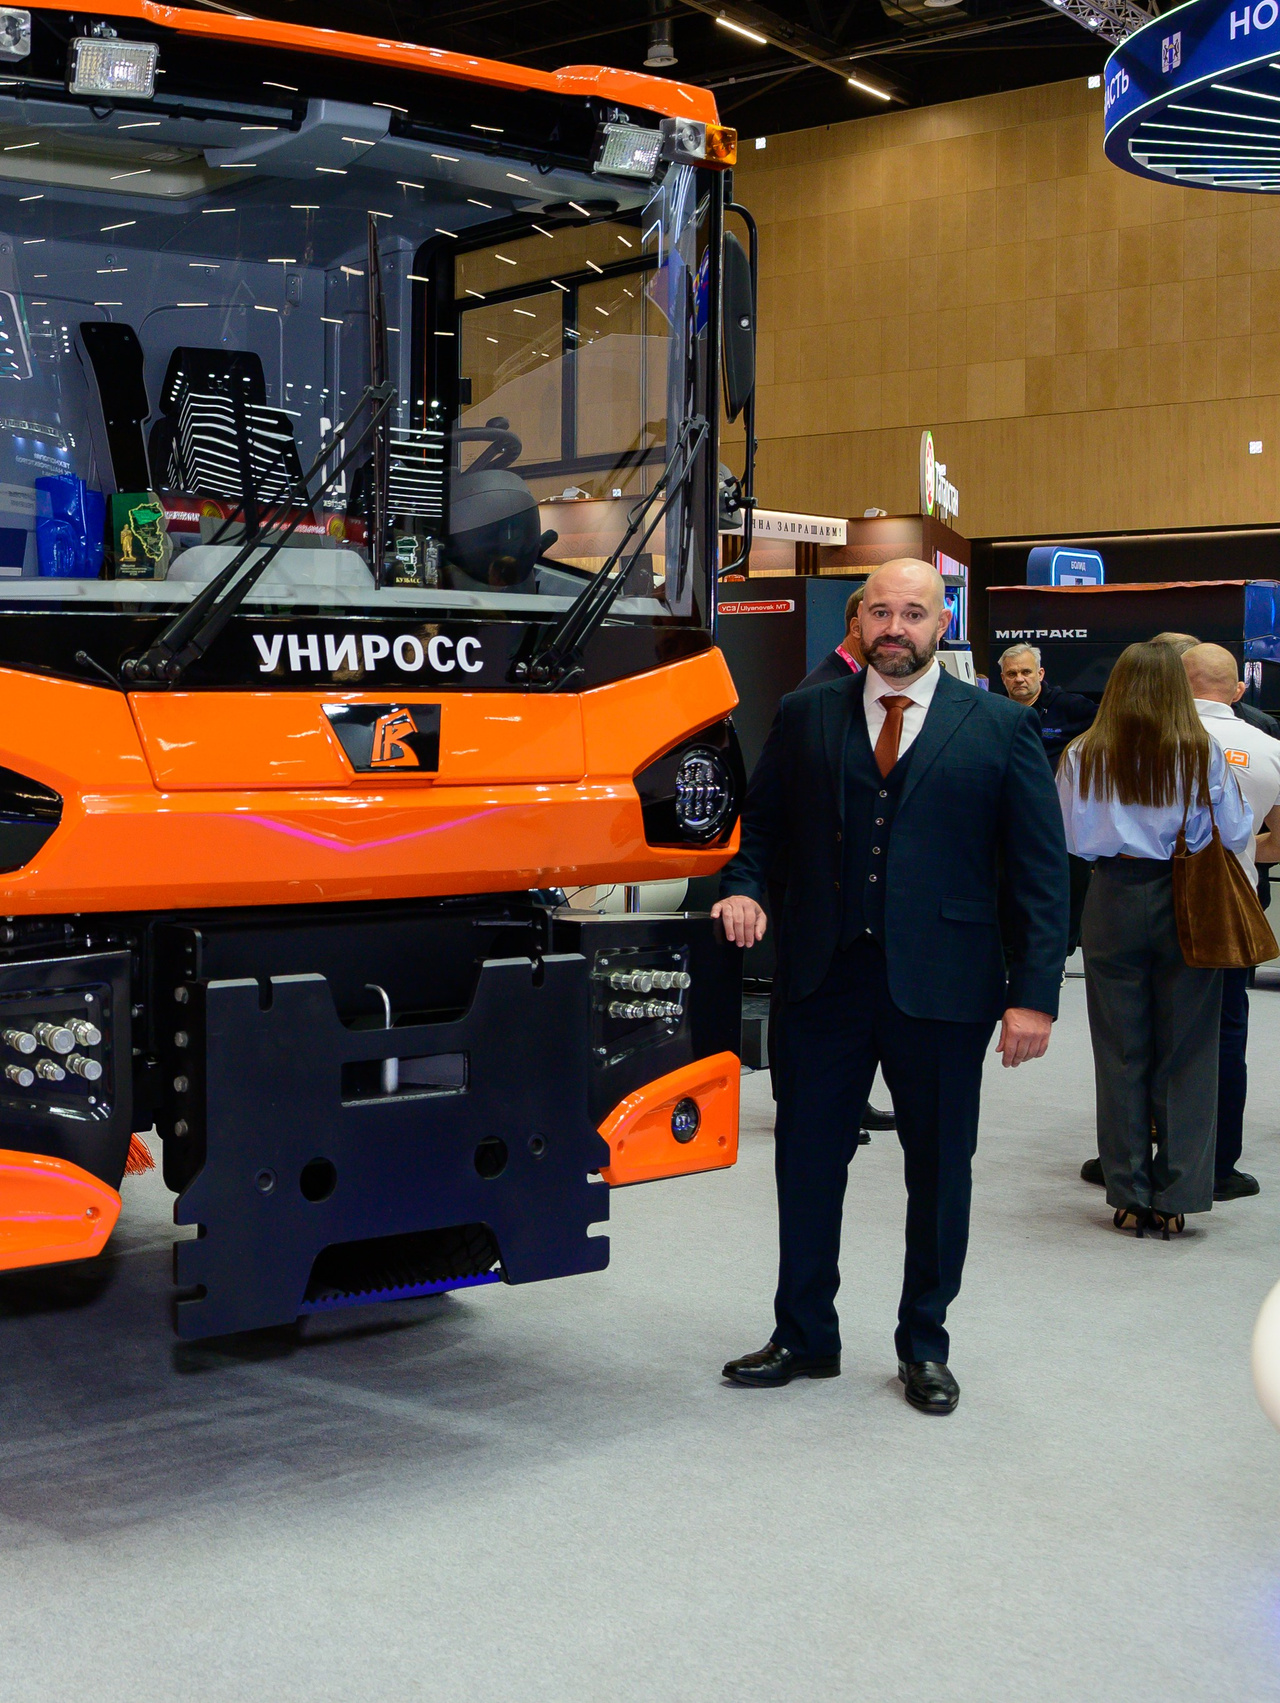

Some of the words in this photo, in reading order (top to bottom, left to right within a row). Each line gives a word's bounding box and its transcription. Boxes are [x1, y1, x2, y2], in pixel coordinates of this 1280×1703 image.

[777, 521, 842, 538] ЗАПРАШАЕМ!
[1070, 560, 1087, 572] БОЛИД
[740, 603, 774, 612] Ulyanovsk
[995, 629, 1088, 639] МИТРАКС
[252, 634, 484, 672] УНИРОСС
